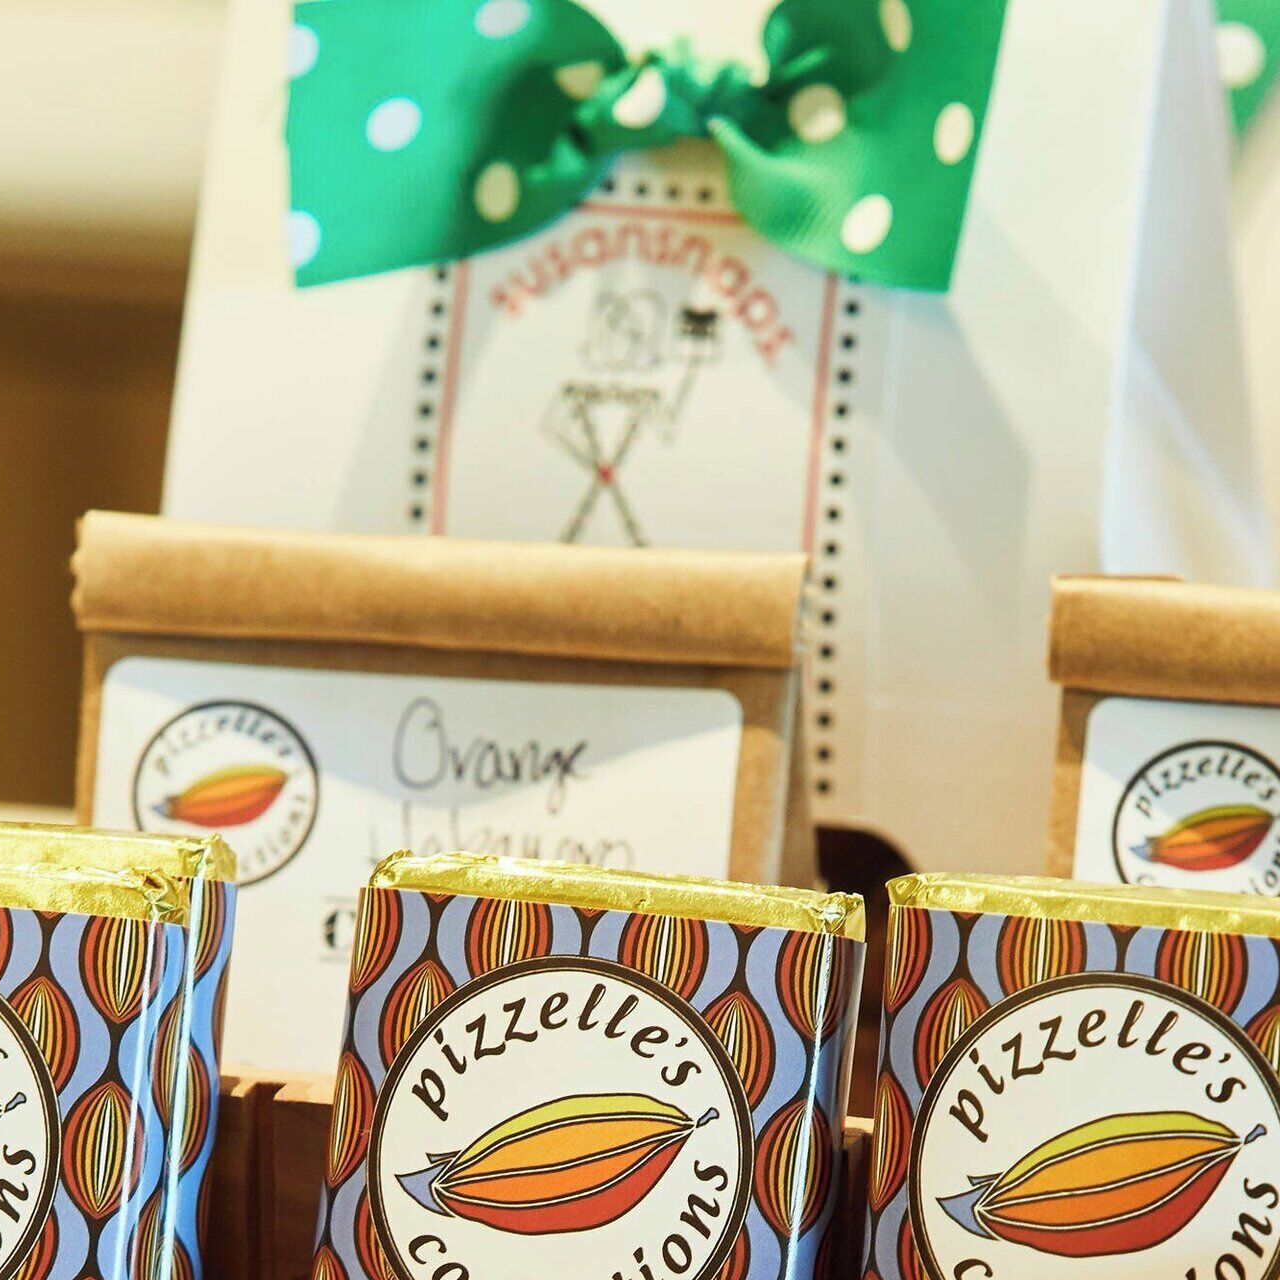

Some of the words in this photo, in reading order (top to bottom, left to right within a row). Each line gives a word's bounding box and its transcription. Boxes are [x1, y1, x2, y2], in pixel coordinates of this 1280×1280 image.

[393, 697, 592, 814] Orange
[412, 983, 702, 1122] pizzelle's
[949, 999, 1247, 1142] pizzelle's
